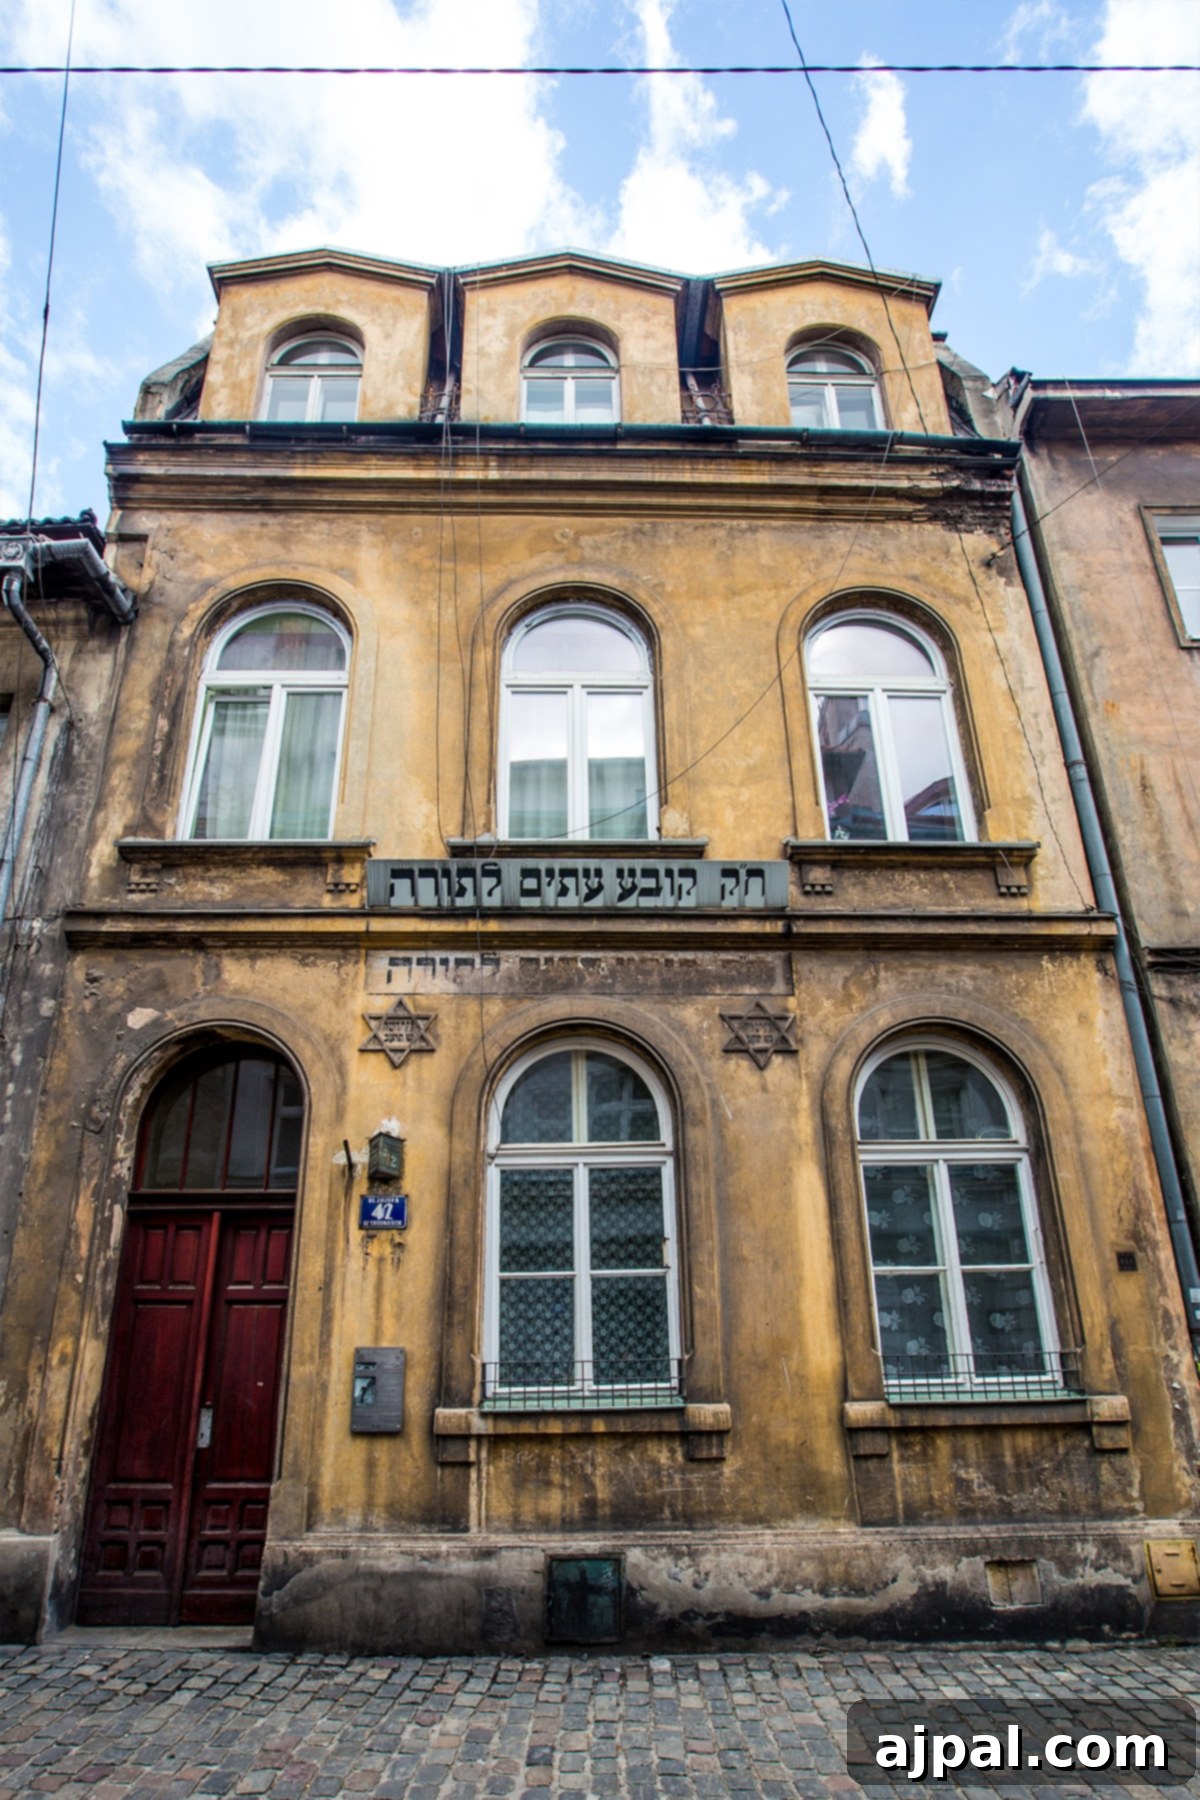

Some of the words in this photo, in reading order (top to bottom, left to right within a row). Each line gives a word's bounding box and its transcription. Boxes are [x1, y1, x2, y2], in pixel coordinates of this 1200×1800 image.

[389, 862, 502, 899] לתורה
[519, 867, 605, 903] עתים
[616, 867, 698, 903] קובע
[371, 1203, 394, 1220] 42
